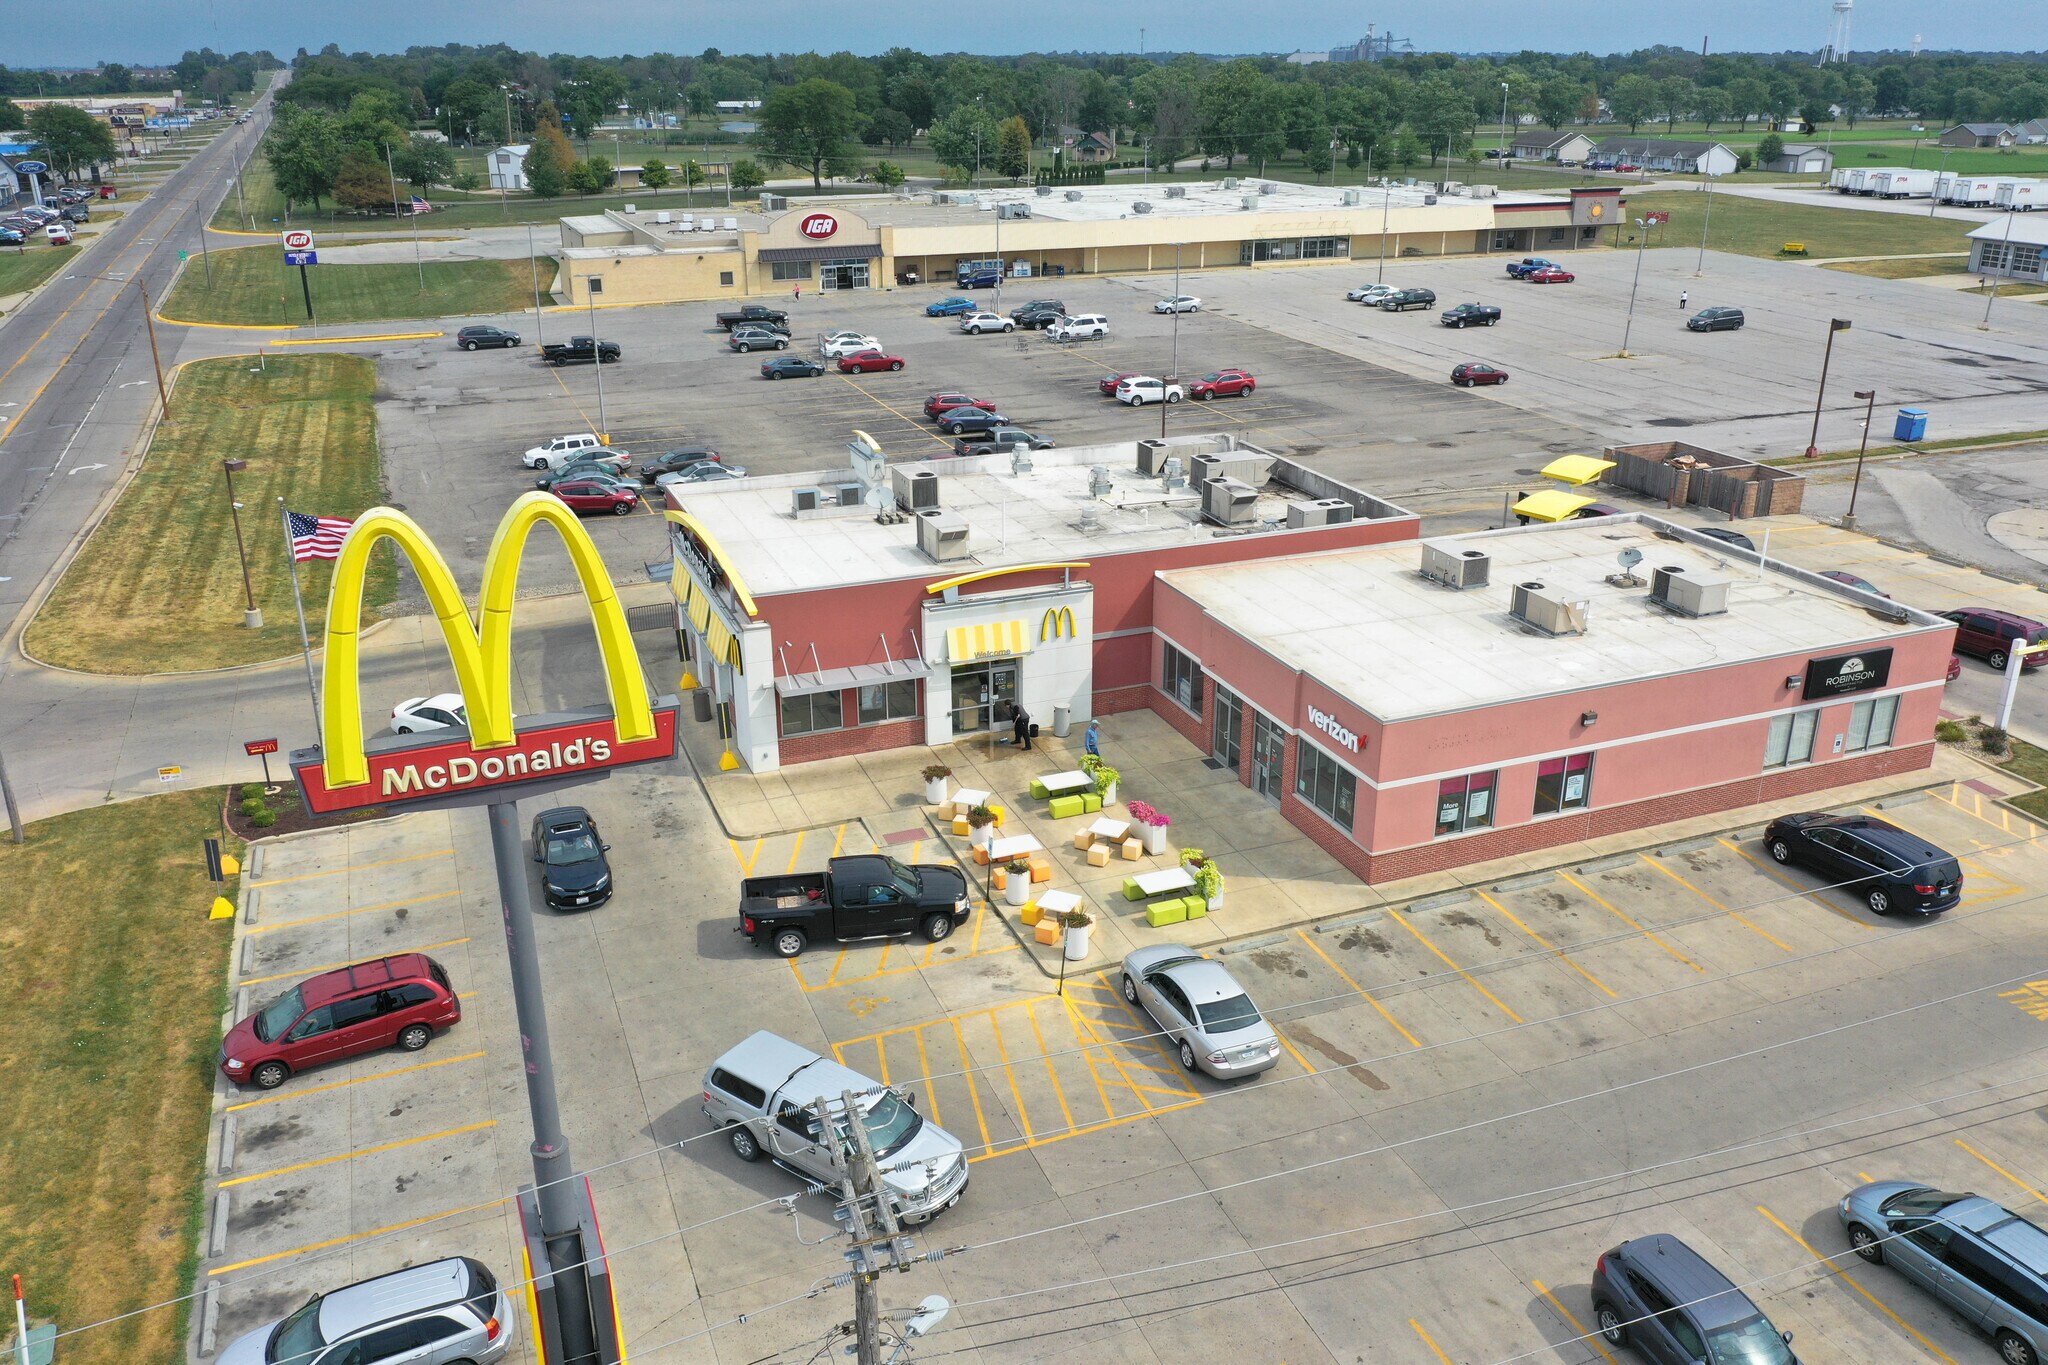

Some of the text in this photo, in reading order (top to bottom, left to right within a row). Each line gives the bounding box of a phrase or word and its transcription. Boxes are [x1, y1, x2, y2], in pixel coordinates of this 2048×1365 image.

[22, 163, 40, 172] Ford
[806, 218, 834, 234] IGA
[288, 235, 308, 245] IGA
[974, 649, 1011, 659] Welcome
[1825, 670, 1876, 686] ROBINSON
[1307, 704, 1359, 753] verizon
[382, 737, 612, 796] McDonald's
[1443, 802, 1459, 810] More
